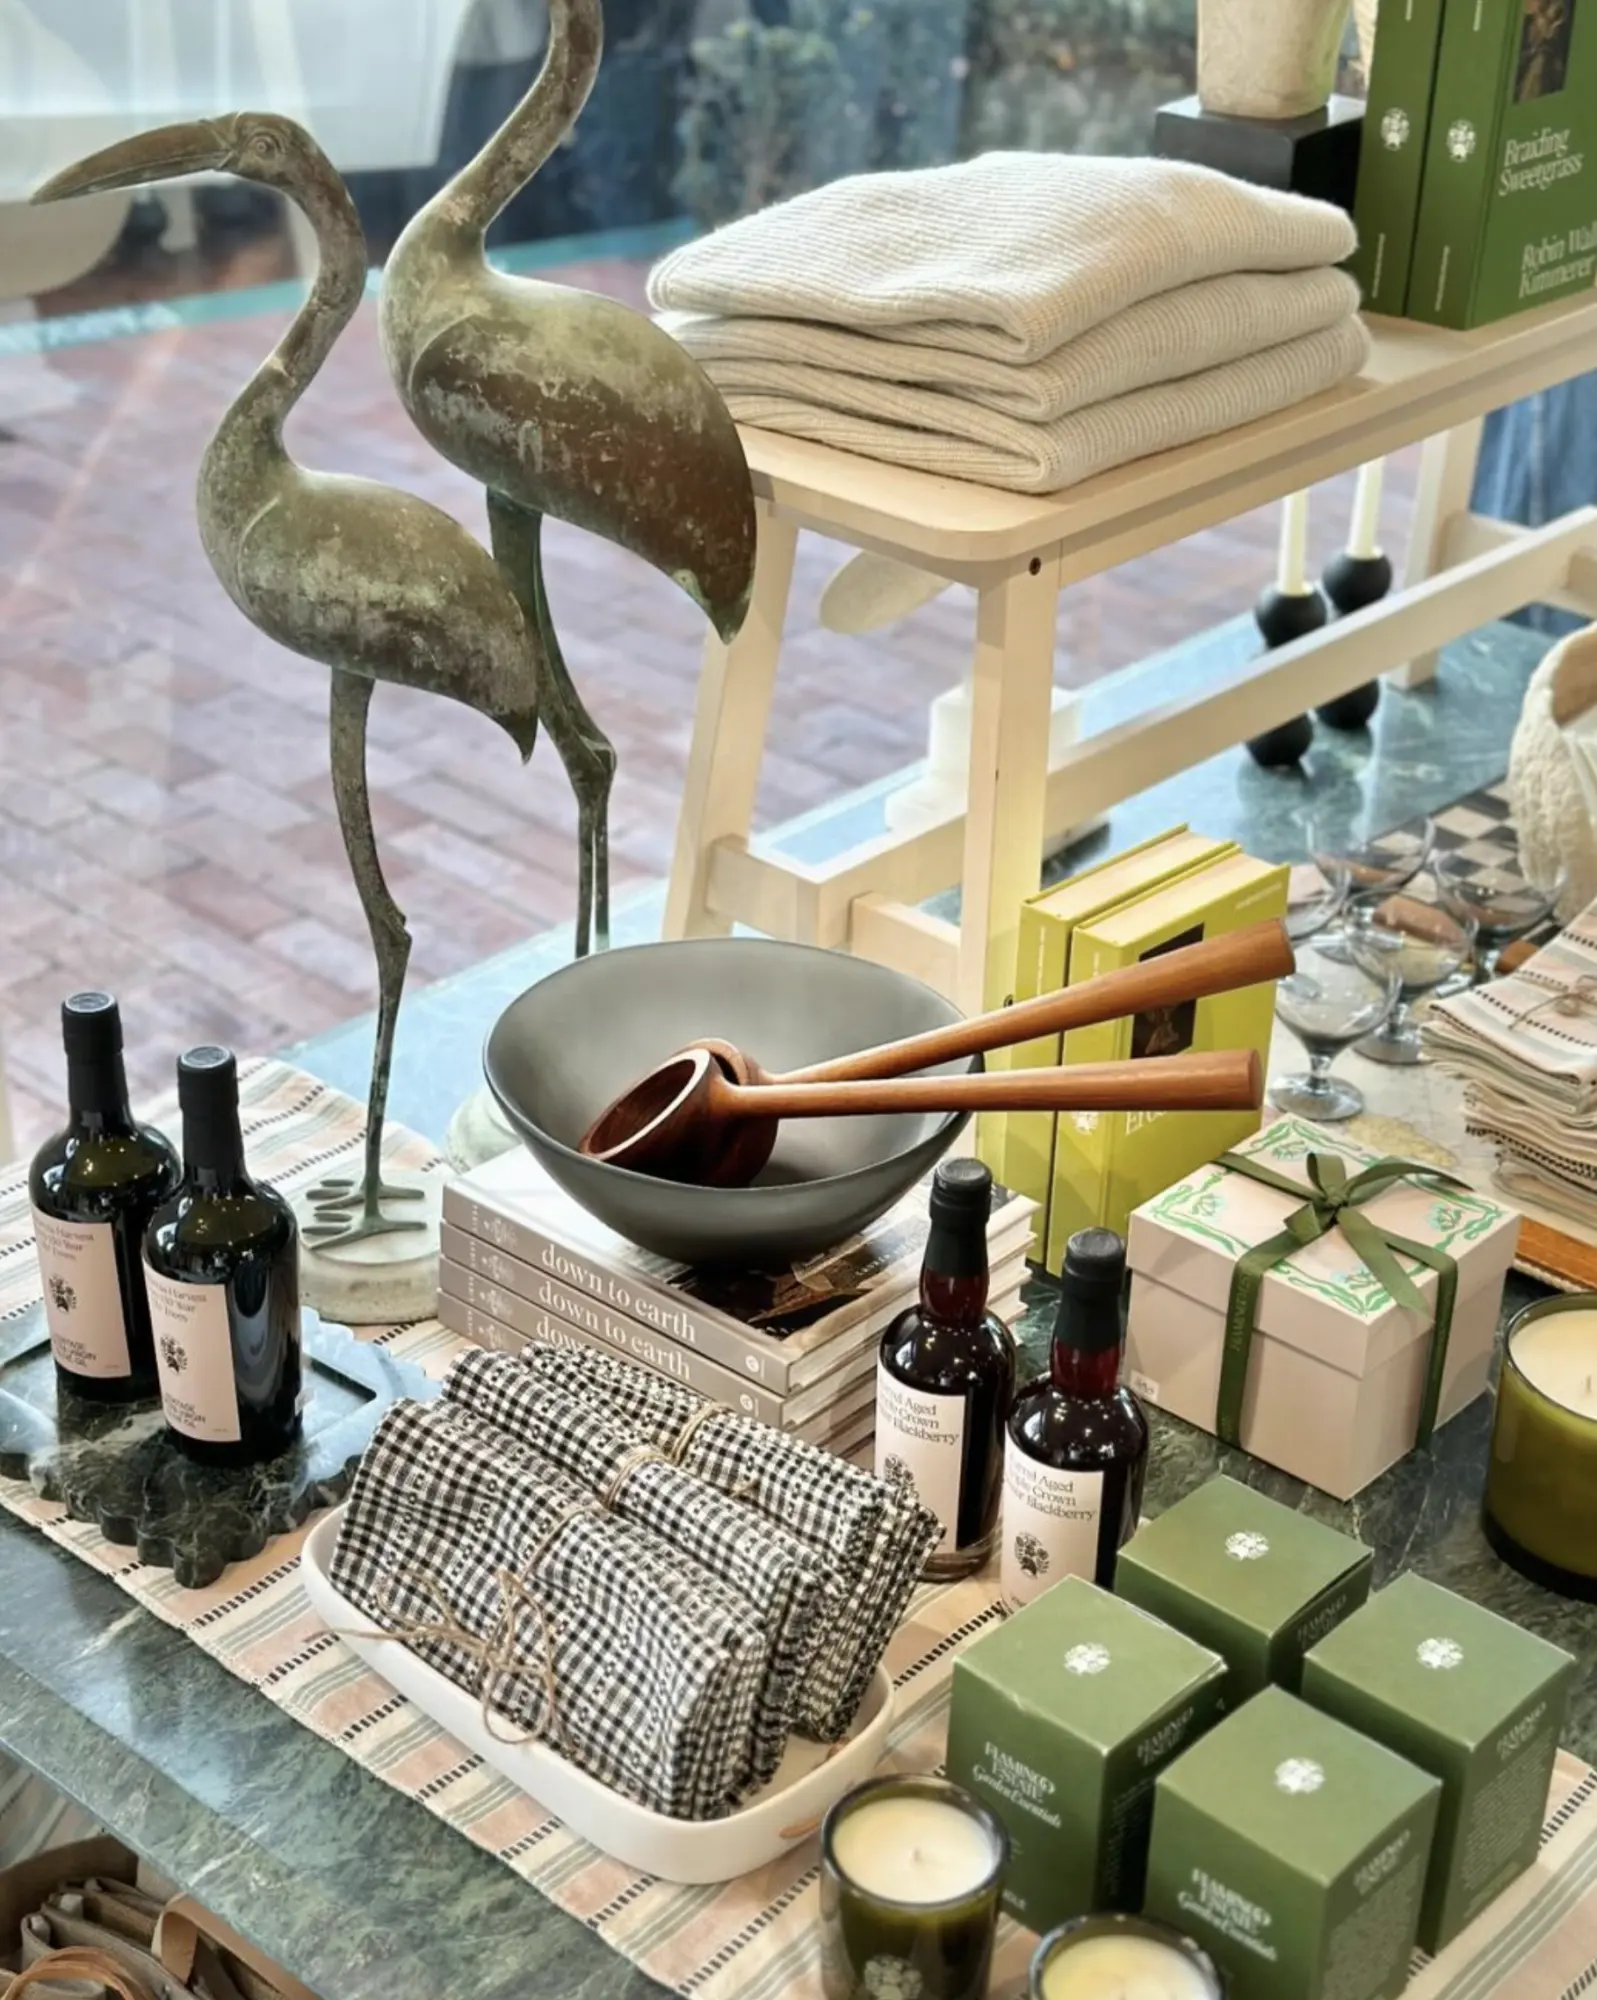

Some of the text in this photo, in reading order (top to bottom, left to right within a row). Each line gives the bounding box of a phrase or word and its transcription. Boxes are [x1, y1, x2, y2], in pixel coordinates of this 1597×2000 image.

[1503, 126, 1571, 168] Braiding
[1498, 153, 1584, 196] Sweetgrass
[1521, 234, 1565, 272] Robin
[1518, 254, 1596, 299] Kimmerer
[541, 1243, 696, 1343] down to earth
[536, 1315, 588, 1350] dow
[539, 1281, 691, 1381] down to earth
[897, 1408, 940, 1429] Crown
[905, 1397, 937, 1416] Aged
[1032, 1485, 1077, 1507] Crown
[1038, 1475, 1074, 1494] Aged
[1026, 1495, 1098, 1523] Blackberry
